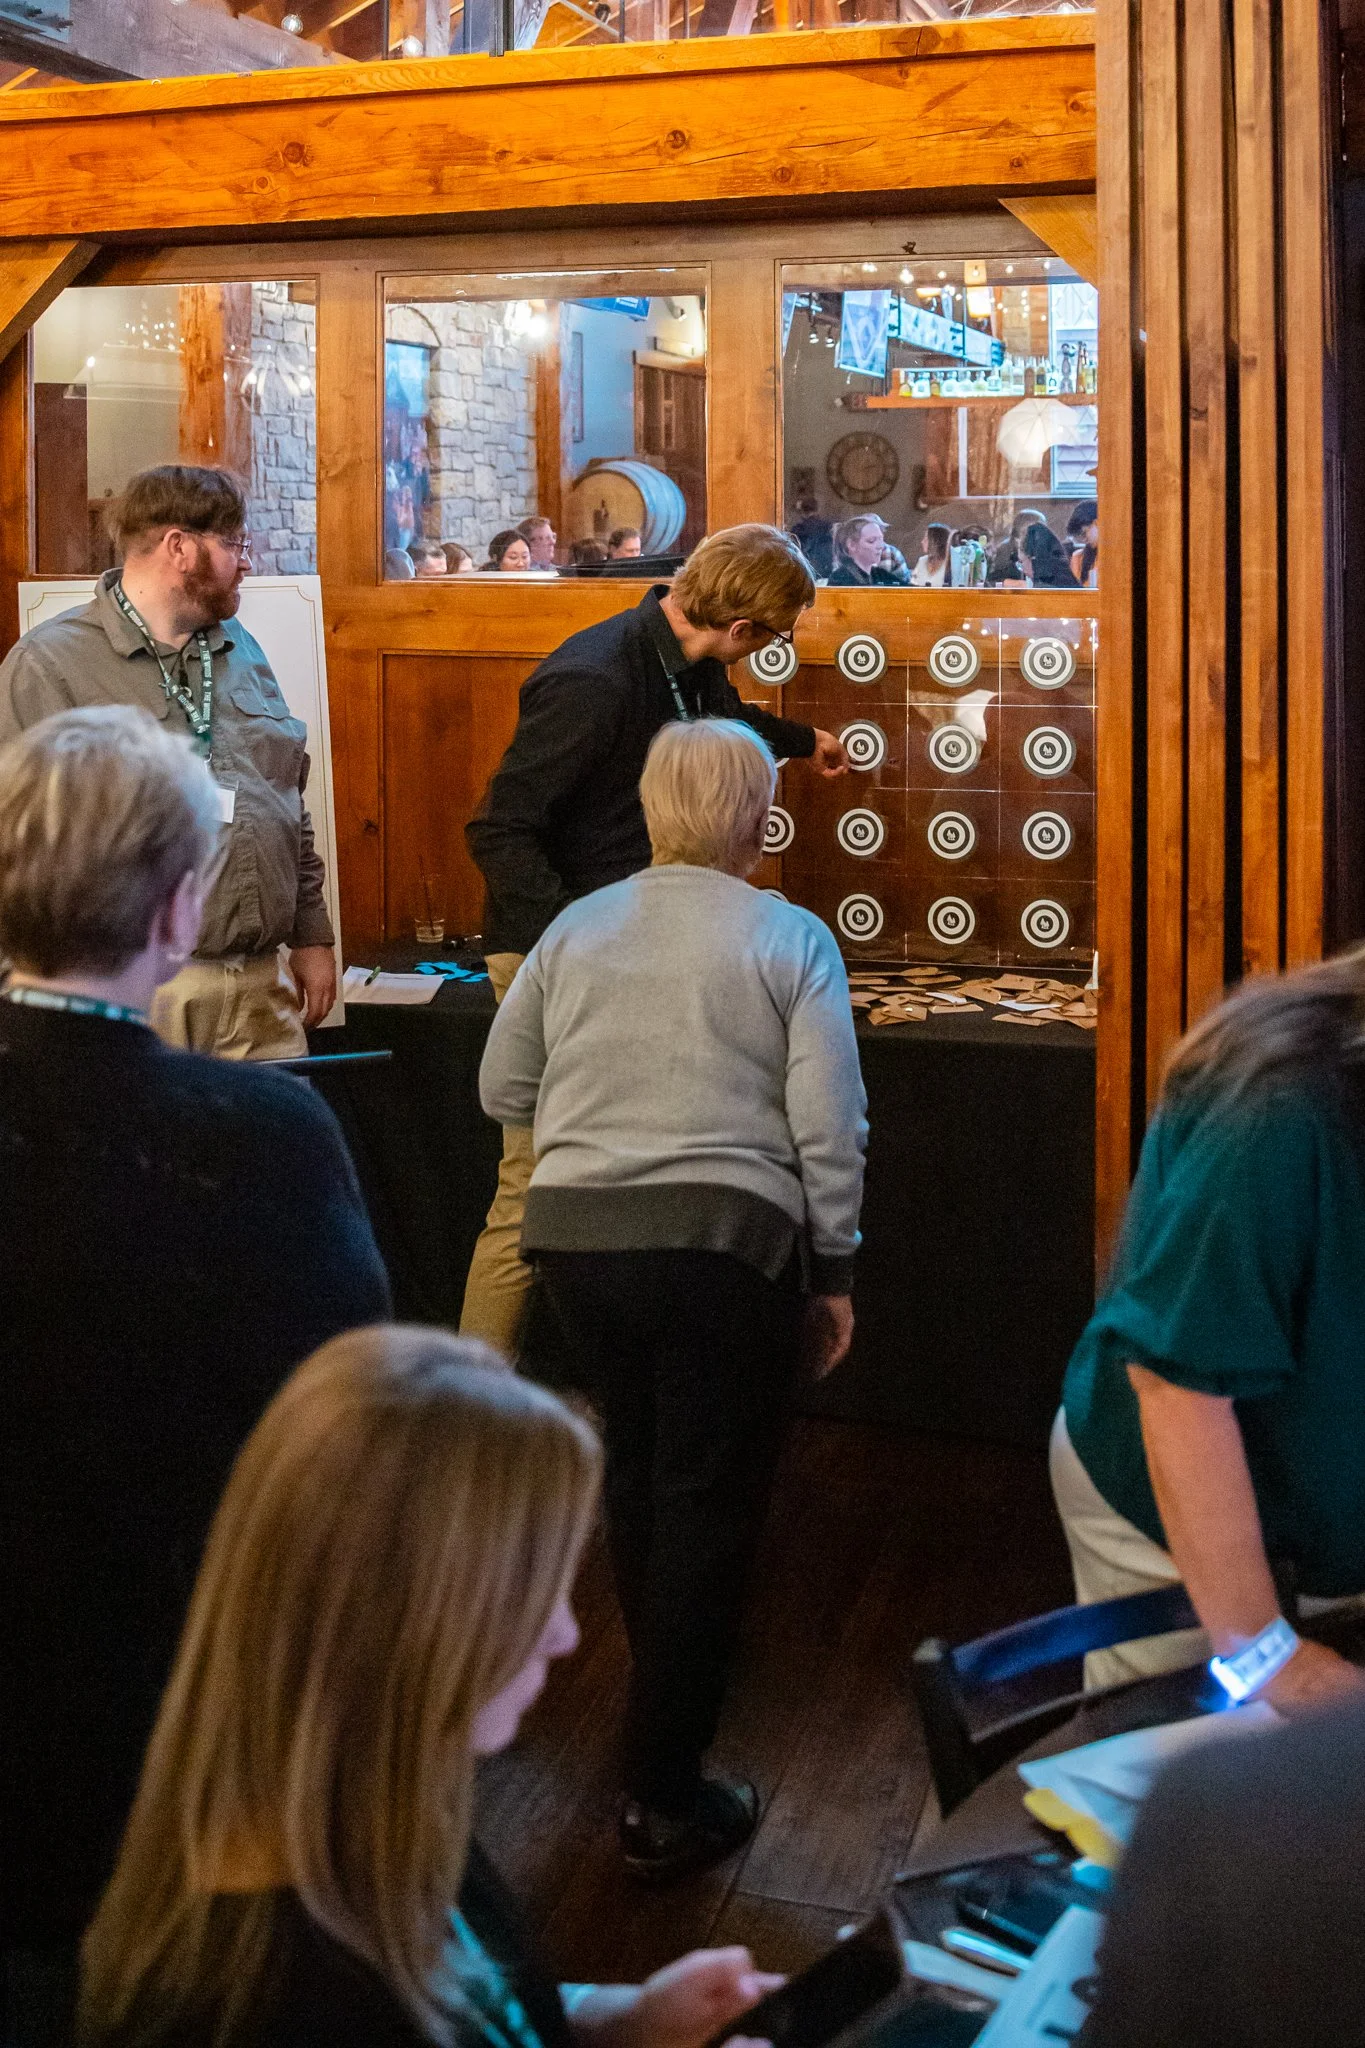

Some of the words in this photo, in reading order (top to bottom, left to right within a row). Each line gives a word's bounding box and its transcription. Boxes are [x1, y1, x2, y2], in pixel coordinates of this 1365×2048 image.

[204, 660, 212, 678] WOODS
[178, 694, 195, 712] WOODS
[203, 691, 212, 702] THE
[191, 710, 201, 722] THE
[202, 702, 211, 721] WOODS
